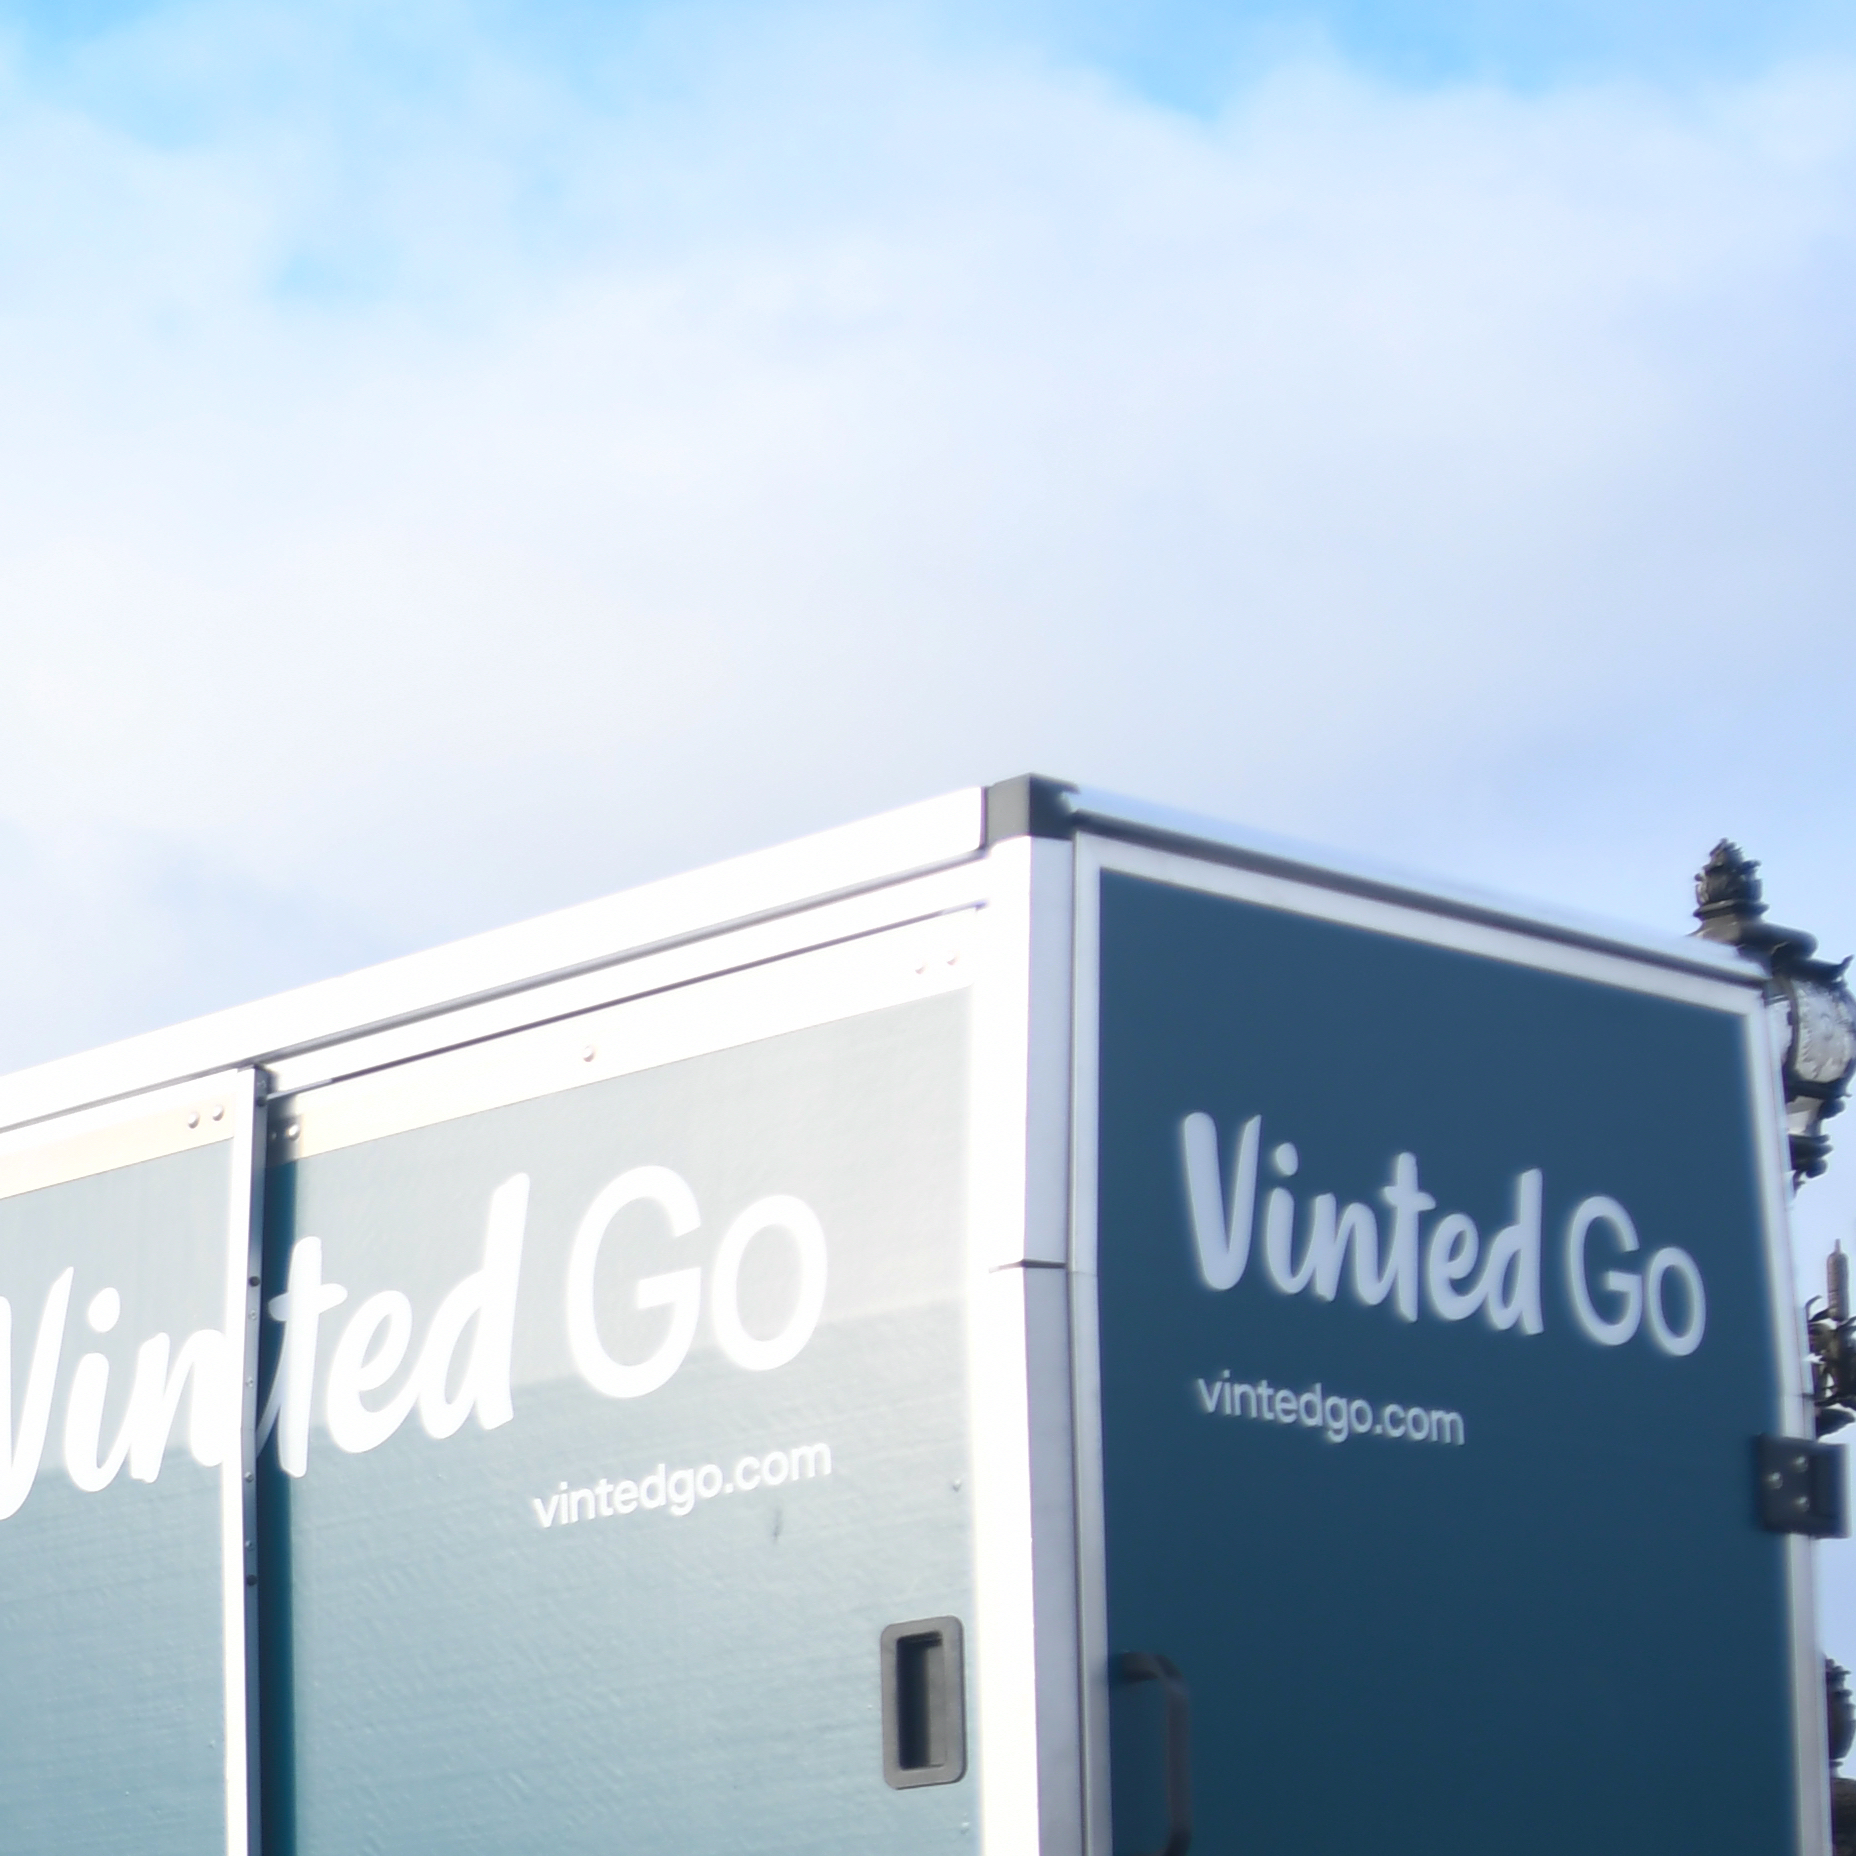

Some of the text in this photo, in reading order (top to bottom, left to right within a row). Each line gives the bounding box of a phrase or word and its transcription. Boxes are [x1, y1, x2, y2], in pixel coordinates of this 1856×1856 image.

[565, 1165, 828, 1399] Go
[1182, 1111, 1706, 1356] Vinted Go
[533, 1436, 833, 1529] vintedgo.com
[1197, 1369, 1465, 1446] vintedgo.com
